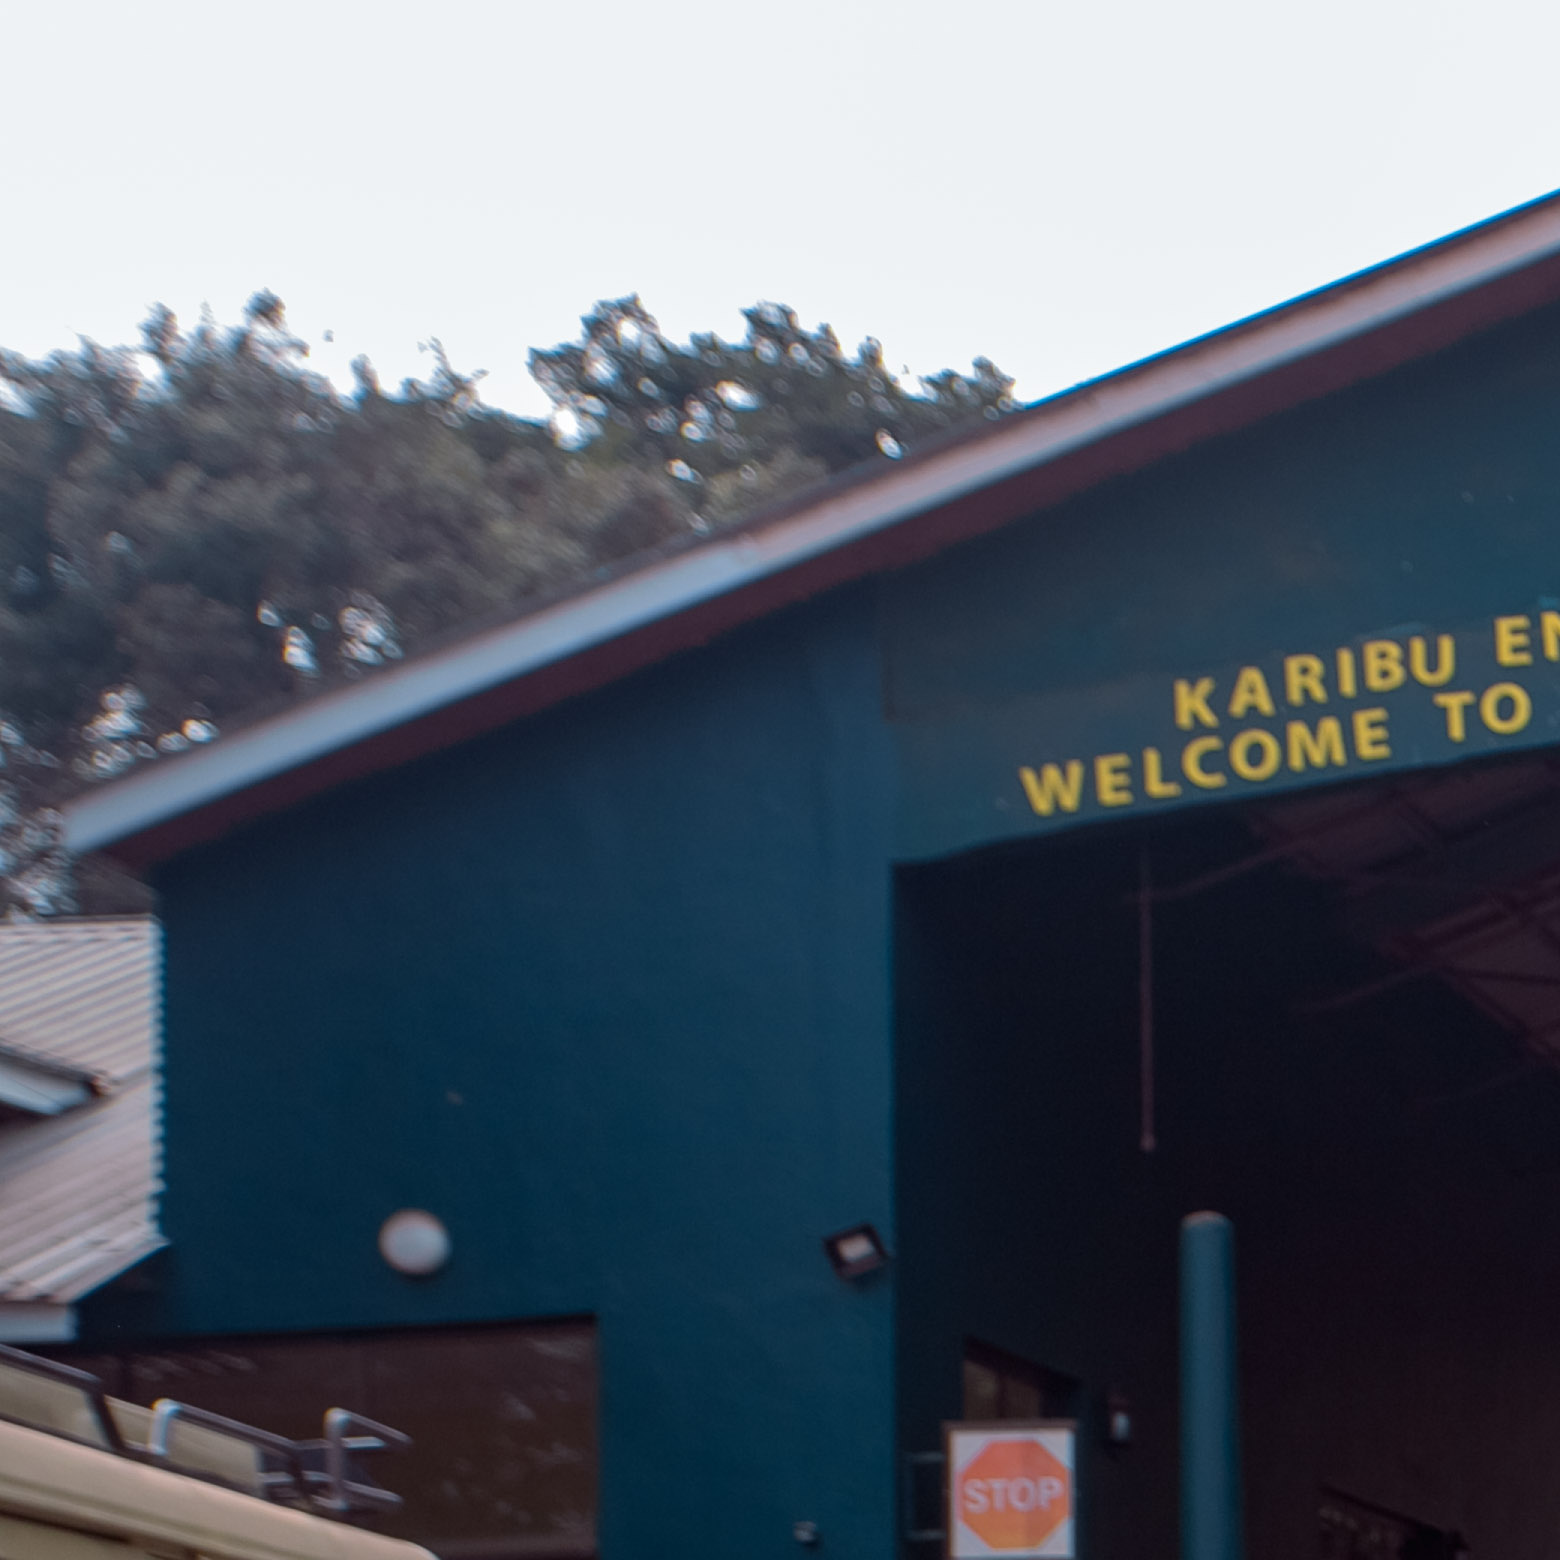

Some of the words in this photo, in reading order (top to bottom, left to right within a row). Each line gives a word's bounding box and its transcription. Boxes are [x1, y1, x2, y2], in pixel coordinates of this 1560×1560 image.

[1174, 635, 1455, 731] KARIBU
[1019, 708, 1392, 817] WELCOME
[1434, 683, 1533, 742] TO
[963, 1476, 1065, 1514] STOP
